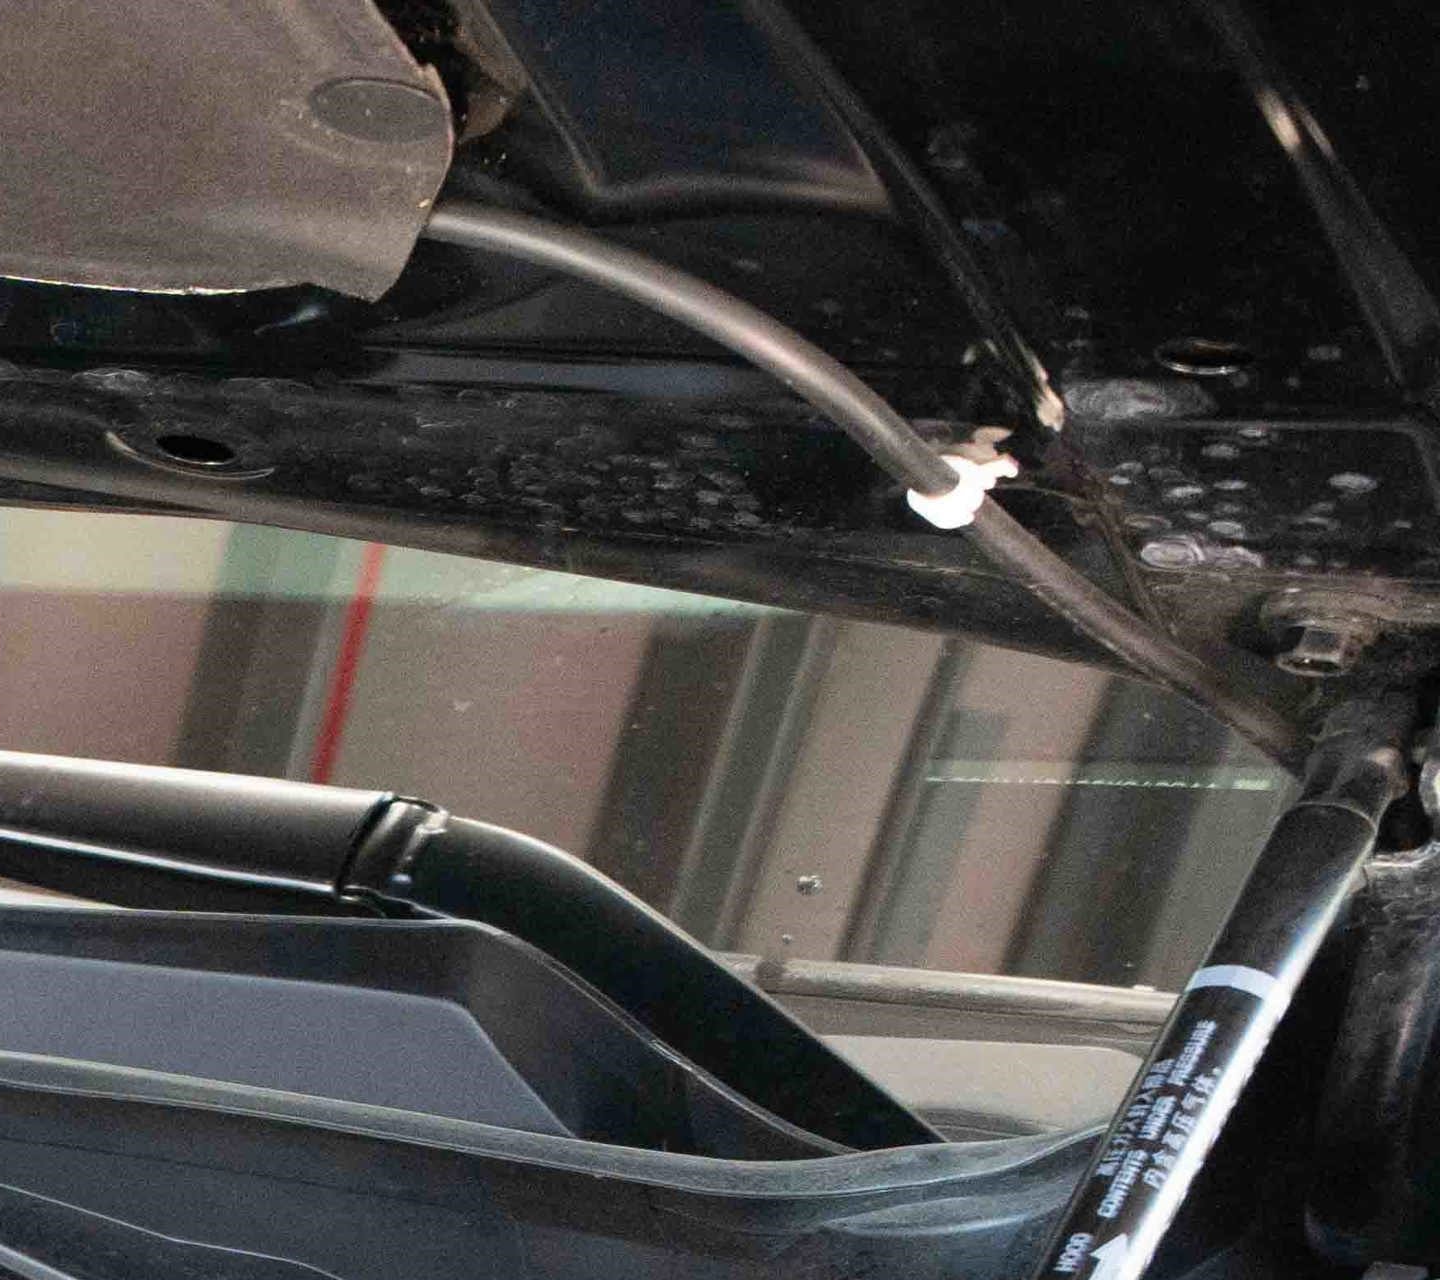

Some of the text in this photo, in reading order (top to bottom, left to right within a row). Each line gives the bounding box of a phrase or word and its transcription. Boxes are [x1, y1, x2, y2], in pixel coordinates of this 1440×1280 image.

[1097, 1148, 1150, 1218] CONTENTS
[1136, 1095, 1178, 1141] UNDER
[1167, 1020, 1218, 1086] PRESSURE
[1053, 1231, 1094, 1273] HOOD
